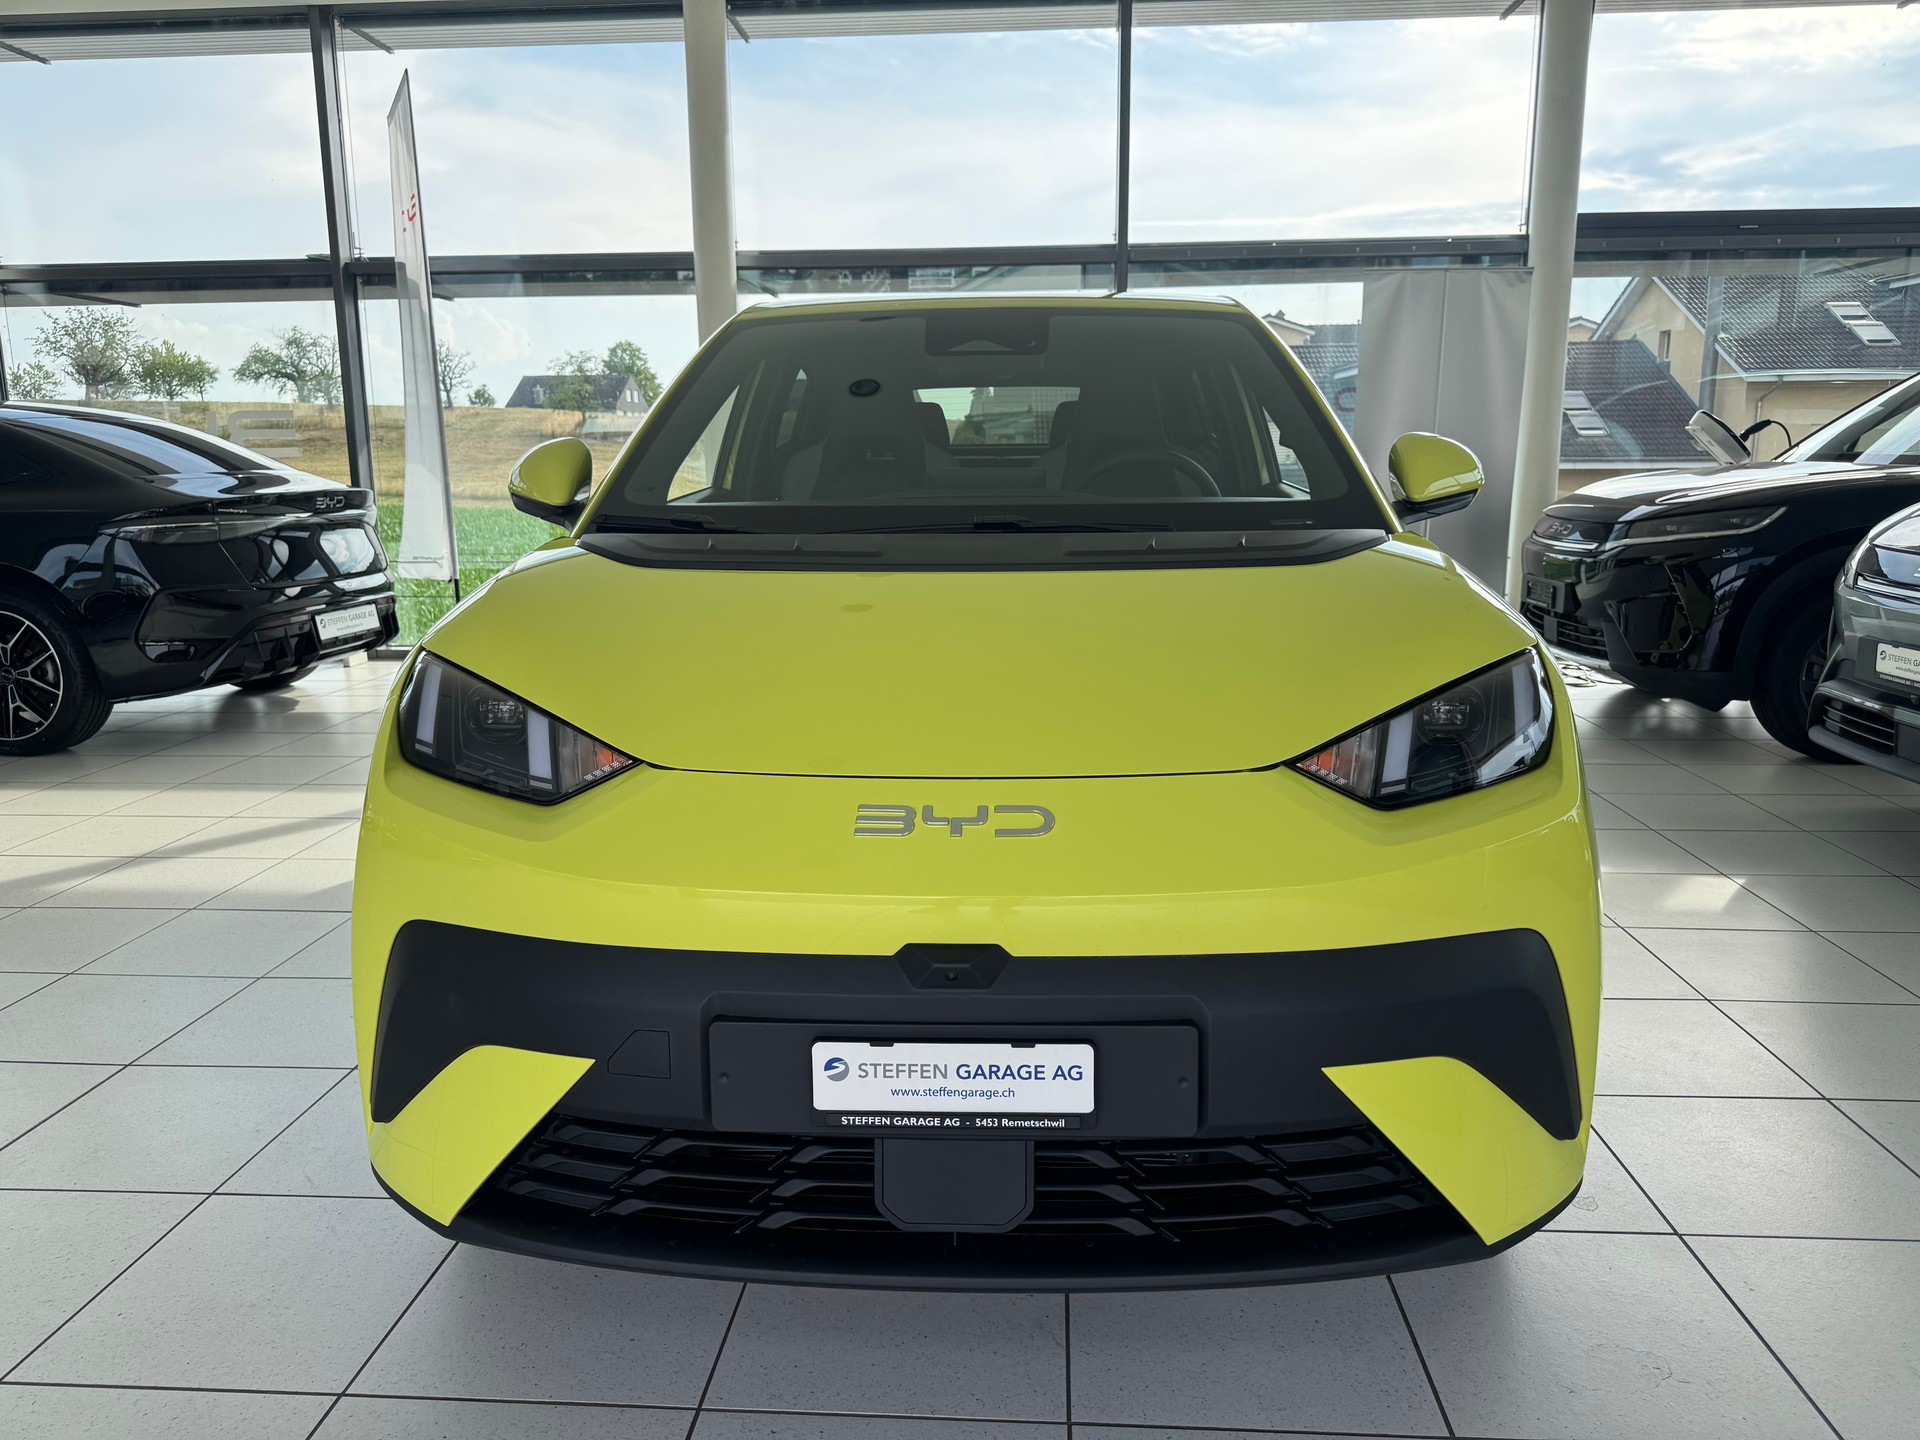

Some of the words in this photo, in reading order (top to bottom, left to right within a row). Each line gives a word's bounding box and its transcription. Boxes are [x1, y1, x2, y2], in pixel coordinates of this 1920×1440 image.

[316, 496, 345, 508] BYD
[1549, 522, 1573, 534] BYD
[327, 616, 348, 626] STEFFEN
[348, 611, 367, 621] GARAGE
[1888, 654, 1912, 665] STEFFEN
[854, 804, 1055, 837] BYD
[858, 1063, 948, 1079] STEFFEN
[956, 1064, 1046, 1080] GARAGE
[1051, 1065, 1083, 1081] AG
[891, 1087, 1015, 1100] www.steffengarage.ch
[841, 1116, 891, 1125] STEFFEN
[893, 1117, 941, 1126] GARAGE
[943, 1118, 961, 1126] AG
[975, 1118, 999, 1127] 5453
[1001, 1118, 1065, 1128] Remetschwil
